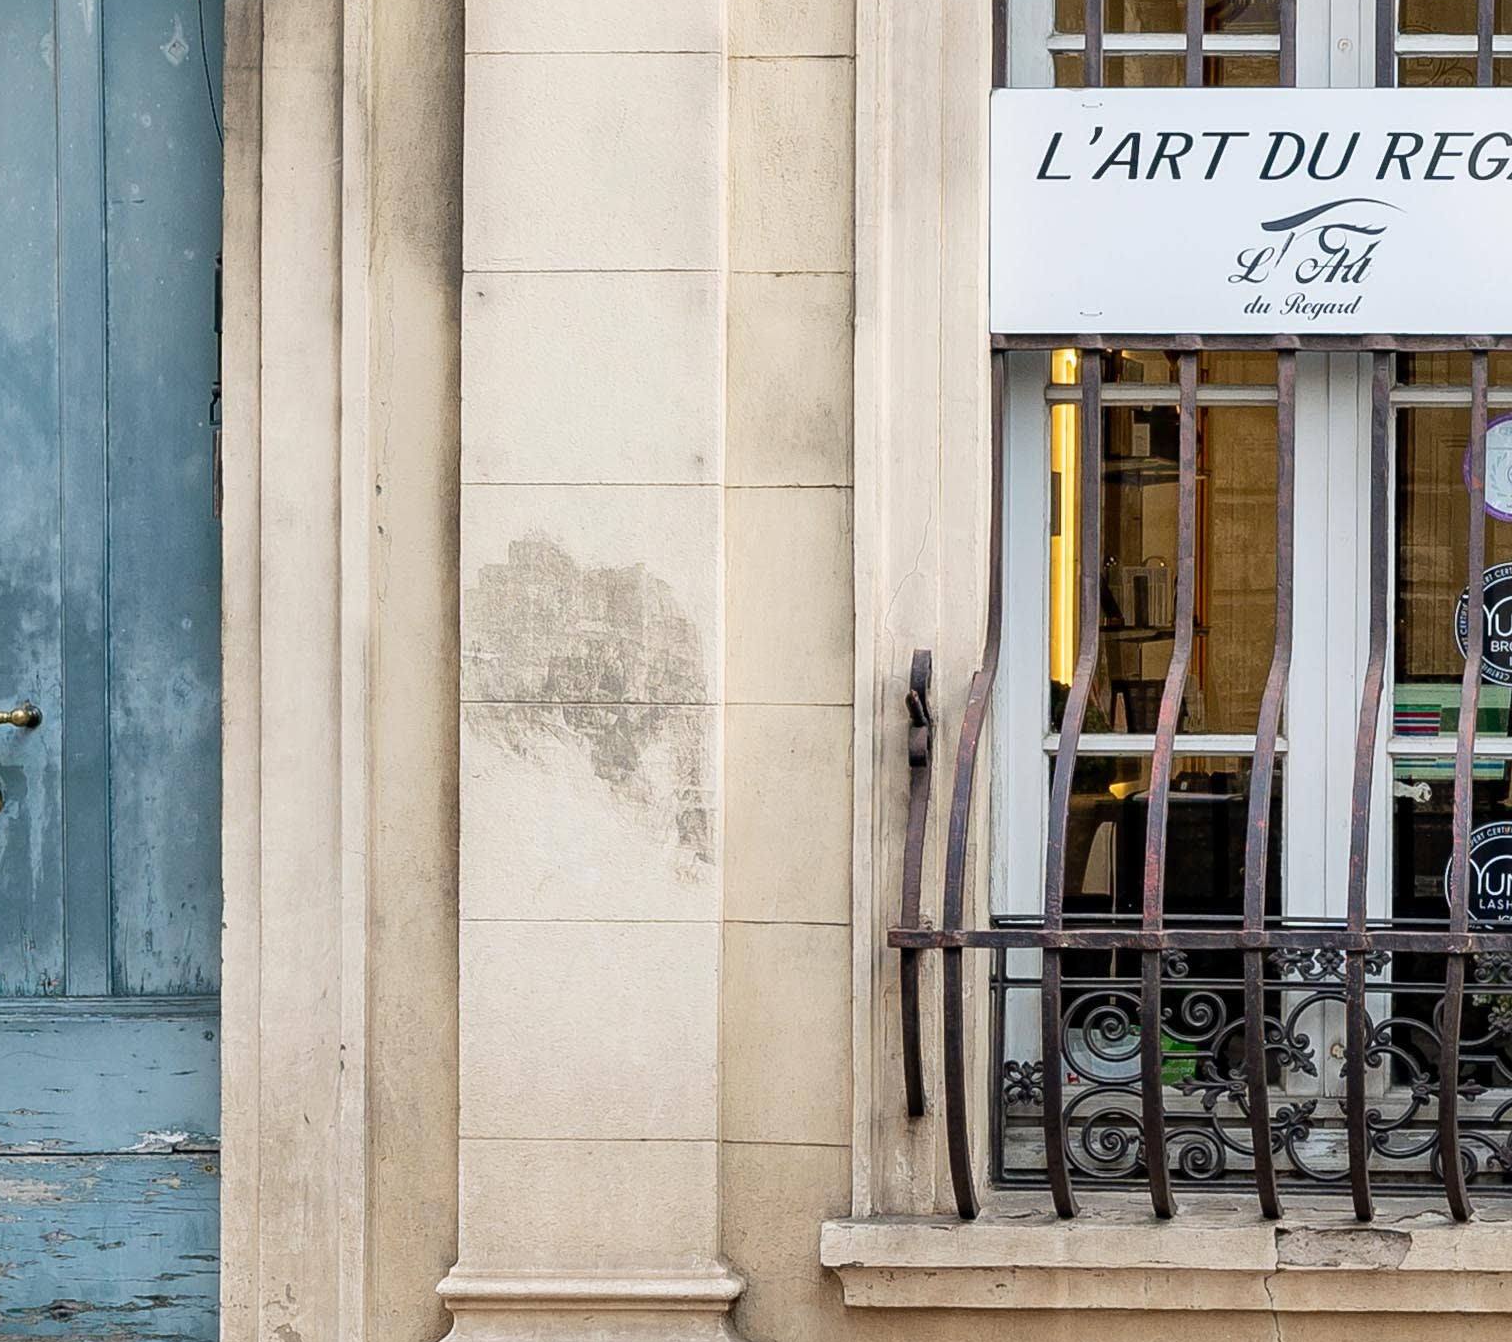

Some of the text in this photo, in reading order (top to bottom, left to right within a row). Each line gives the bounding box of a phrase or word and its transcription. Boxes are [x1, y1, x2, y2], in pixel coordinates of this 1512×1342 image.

[1036, 126, 1250, 181] L'ART
[1260, 132, 1360, 181] DU
[1243, 294, 1362, 321] du Regard
